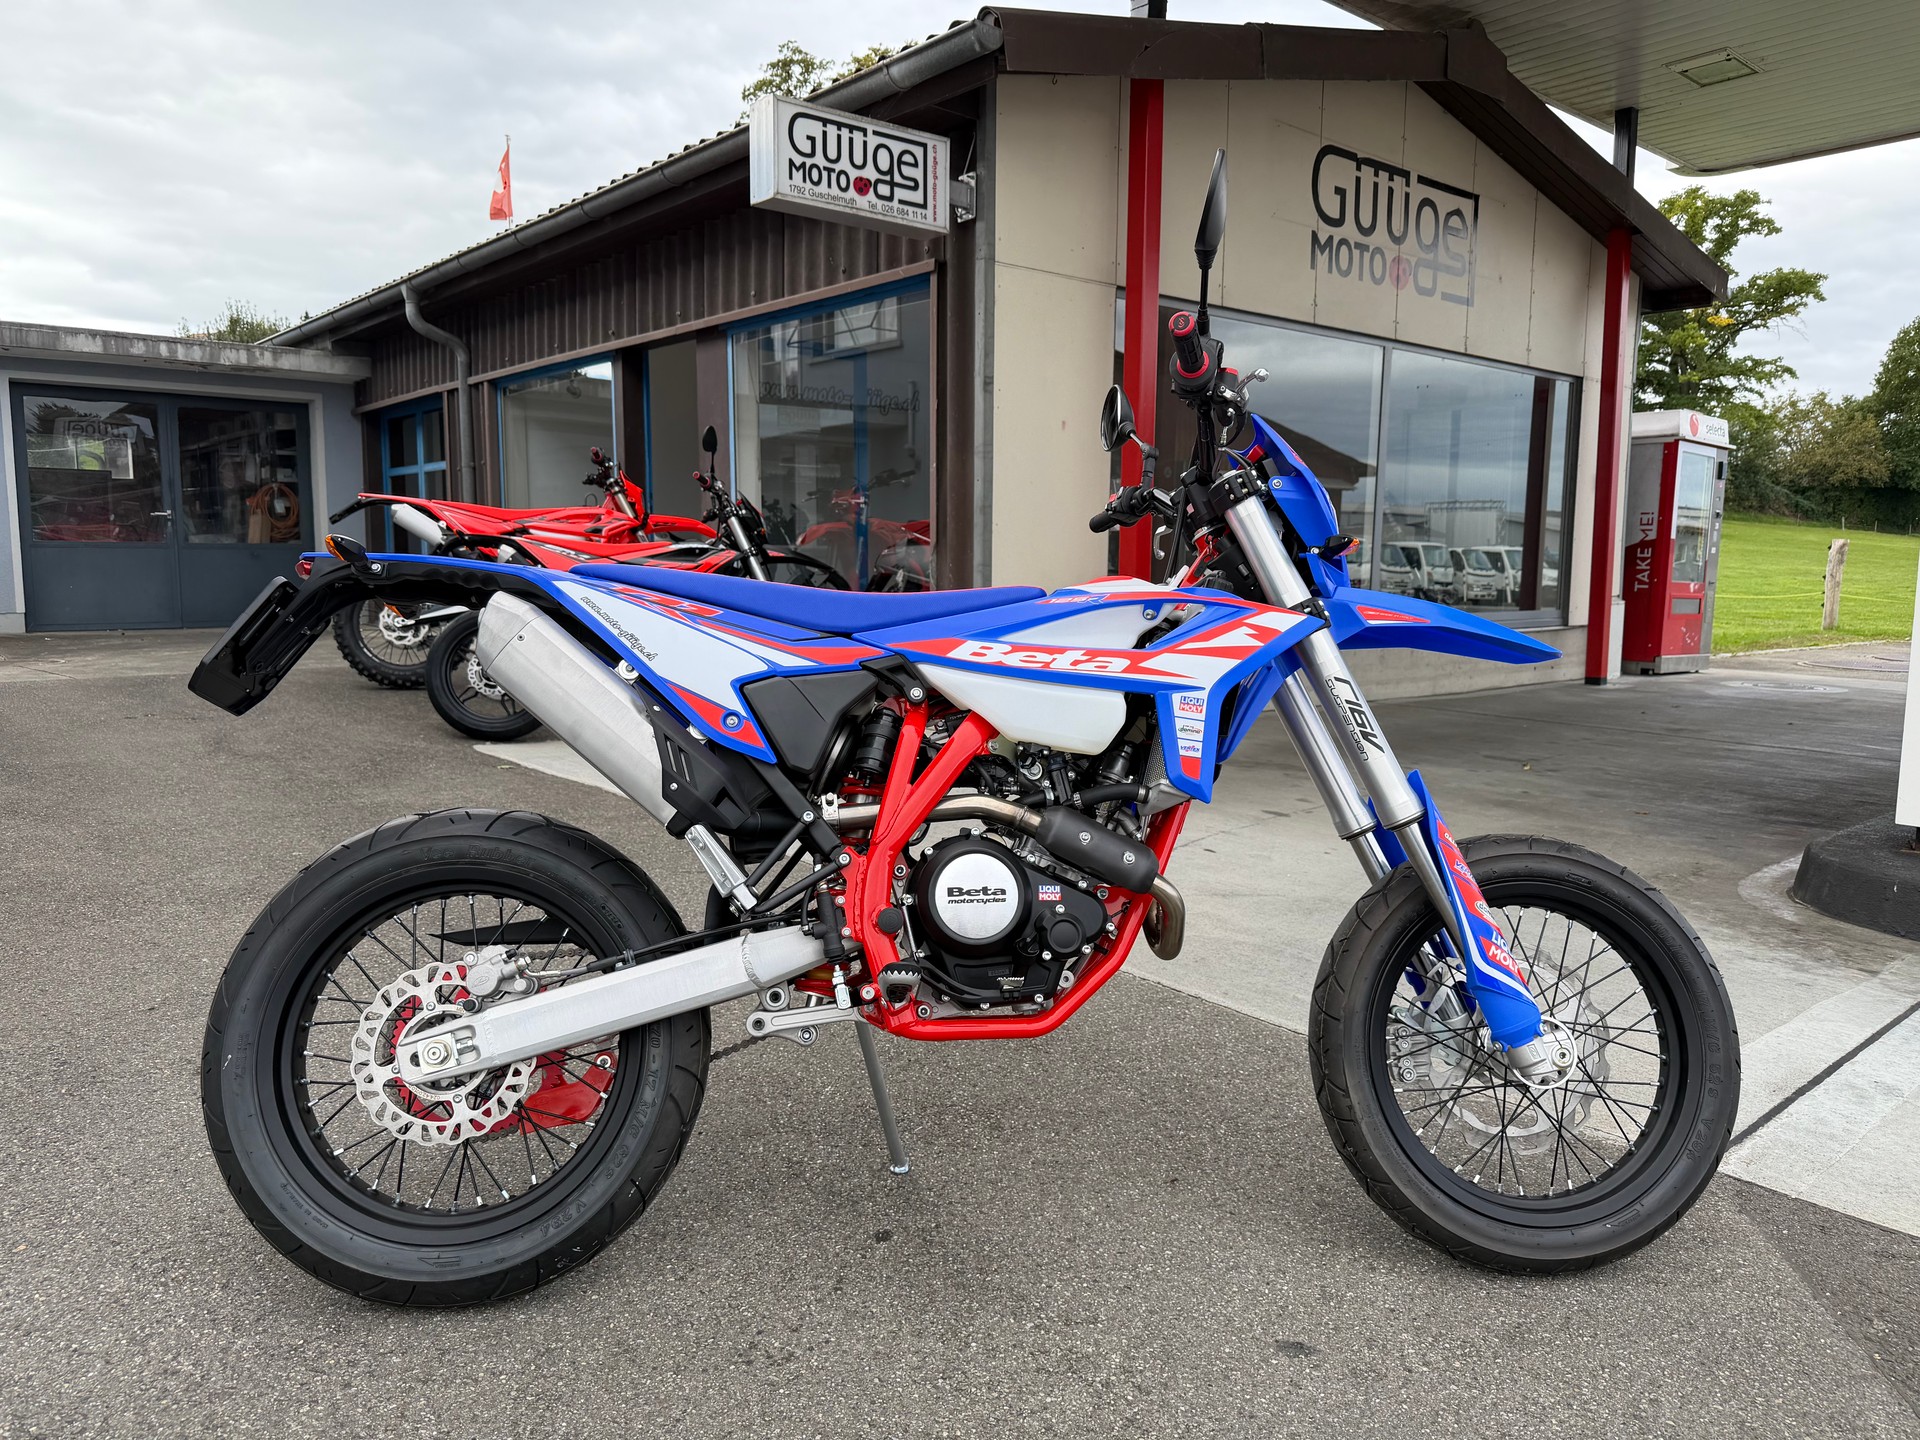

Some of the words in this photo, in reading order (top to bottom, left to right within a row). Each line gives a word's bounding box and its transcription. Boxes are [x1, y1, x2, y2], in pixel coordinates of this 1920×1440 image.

[788, 157, 850, 193] MOTO
[788, 184, 806, 196] 1792
[807, 188, 857, 206] Guschelmuth
[867, 200, 880, 211] Tel.
[881, 204, 895, 214] 026
[896, 207, 910, 217] 684
[912, 209, 918, 219] 11
[920, 211, 928, 221] 14
[1310, 230, 1387, 286] MOTO
[1705, 424, 1726, 437] selecta
[1639, 511, 1655, 542] ME!
[1634, 547, 1652, 592] TAKE
[946, 640, 1131, 672] Beta
[1181, 696, 1204, 705] LIQUI
[1180, 703, 1203, 713] MOLY
[947, 886, 1007, 897] Beta
[1039, 885, 1061, 893] LIQUI
[948, 897, 1007, 905] motorcycles
[1039, 893, 1061, 901] MOLY
